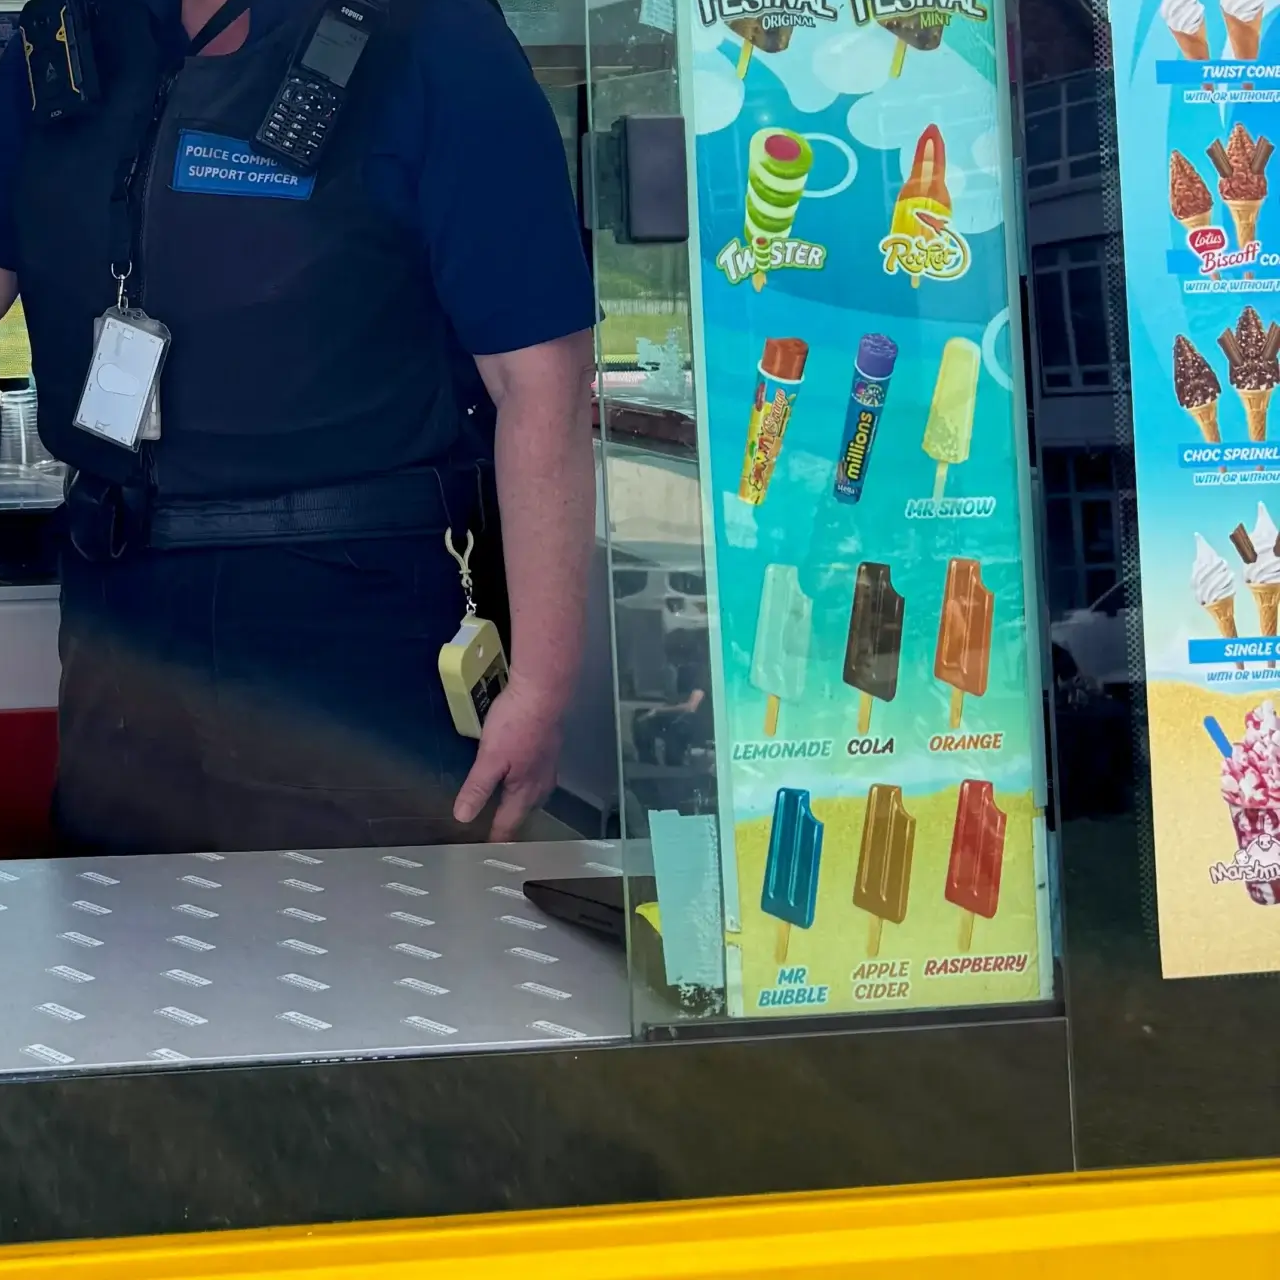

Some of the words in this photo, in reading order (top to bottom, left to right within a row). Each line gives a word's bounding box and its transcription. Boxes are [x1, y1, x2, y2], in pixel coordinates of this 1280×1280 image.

[762, 13, 816, 29] ORIGINAL
[919, 13, 951, 29] MINT
[1202, 65, 1244, 78] TWIST
[1185, 91, 1209, 102] WITH
[1212, 91, 1227, 101] OR
[1230, 91, 1274, 101] WITHOUT
[185, 145, 230, 161] POLICE
[188, 165, 246, 181] SUPPORT
[247, 172, 298, 186] OFFICER
[1193, 231, 1223, 247] Lotus
[881, 234, 960, 275] Rocket
[1201, 242, 1260, 273] Biscoff
[1185, 281, 1211, 291] WITH
[1212, 280, 1228, 290] OR
[1230, 280, 1274, 290] WITHOUT
[847, 411, 873, 480] millions
[1183, 448, 1221, 463] CHOC
[1223, 447, 1280, 461] SPRINKL
[1194, 473, 1221, 484] WITH
[1223, 473, 1238, 483] OR
[906, 500, 934, 517] MR
[936, 499, 994, 516] SNOW
[1224, 641, 1272, 656] SINGLE
[1207, 671, 1233, 681] WITH
[1235, 670, 1249, 681] OR
[732, 740, 832, 760] LEMONADE
[847, 739, 894, 755] COLA
[929, 733, 1003, 752] ORANGE
[1209, 859, 1280, 884] Marshm
[853, 961, 910, 980] APPLE
[924, 954, 1028, 976] RASPBERRY
[778, 968, 807, 984] MR
[759, 986, 828, 1007] BUBBLE
[854, 981, 910, 999] CIDER
